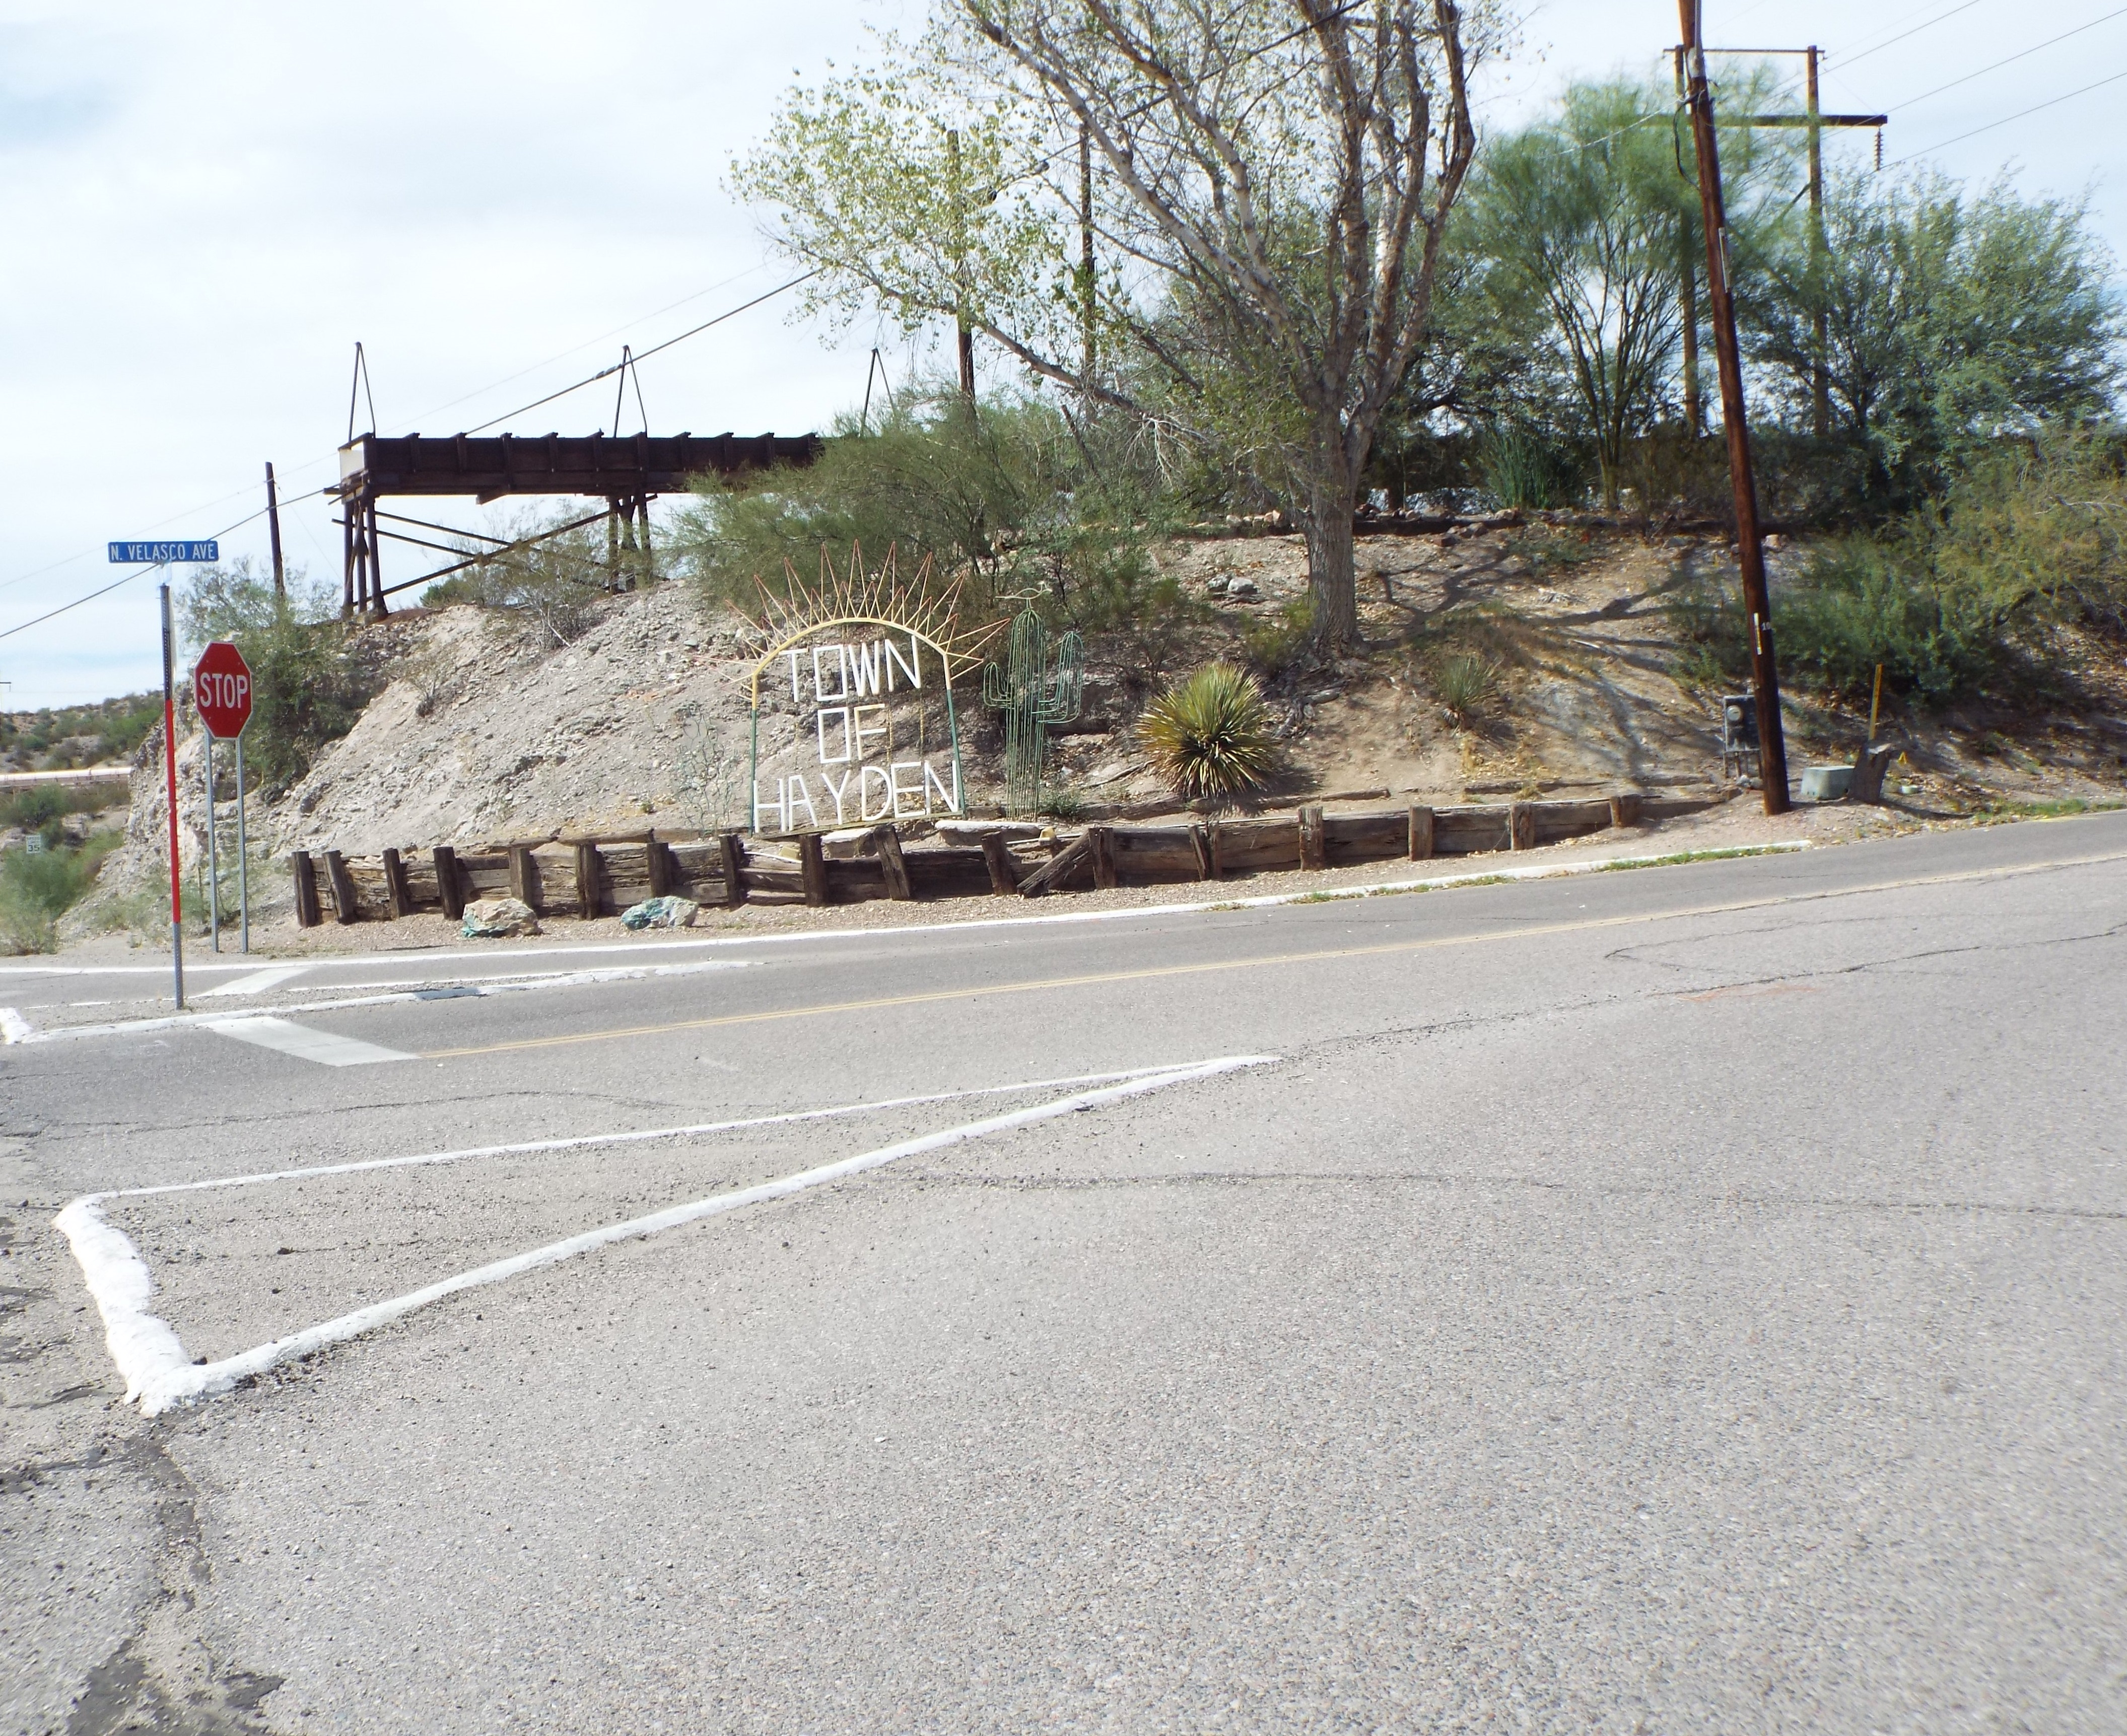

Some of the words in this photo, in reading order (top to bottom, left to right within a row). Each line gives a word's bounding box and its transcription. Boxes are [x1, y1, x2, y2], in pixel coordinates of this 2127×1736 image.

[111, 545, 123, 561] N.
[128, 544, 185, 560] VELASCO
[192, 544, 215, 560] AVE
[199, 672, 248, 709] STOP
[779, 635, 921, 703] TOWN
[817, 704, 887, 764] OF
[753, 760, 959, 834] HAYDEN
